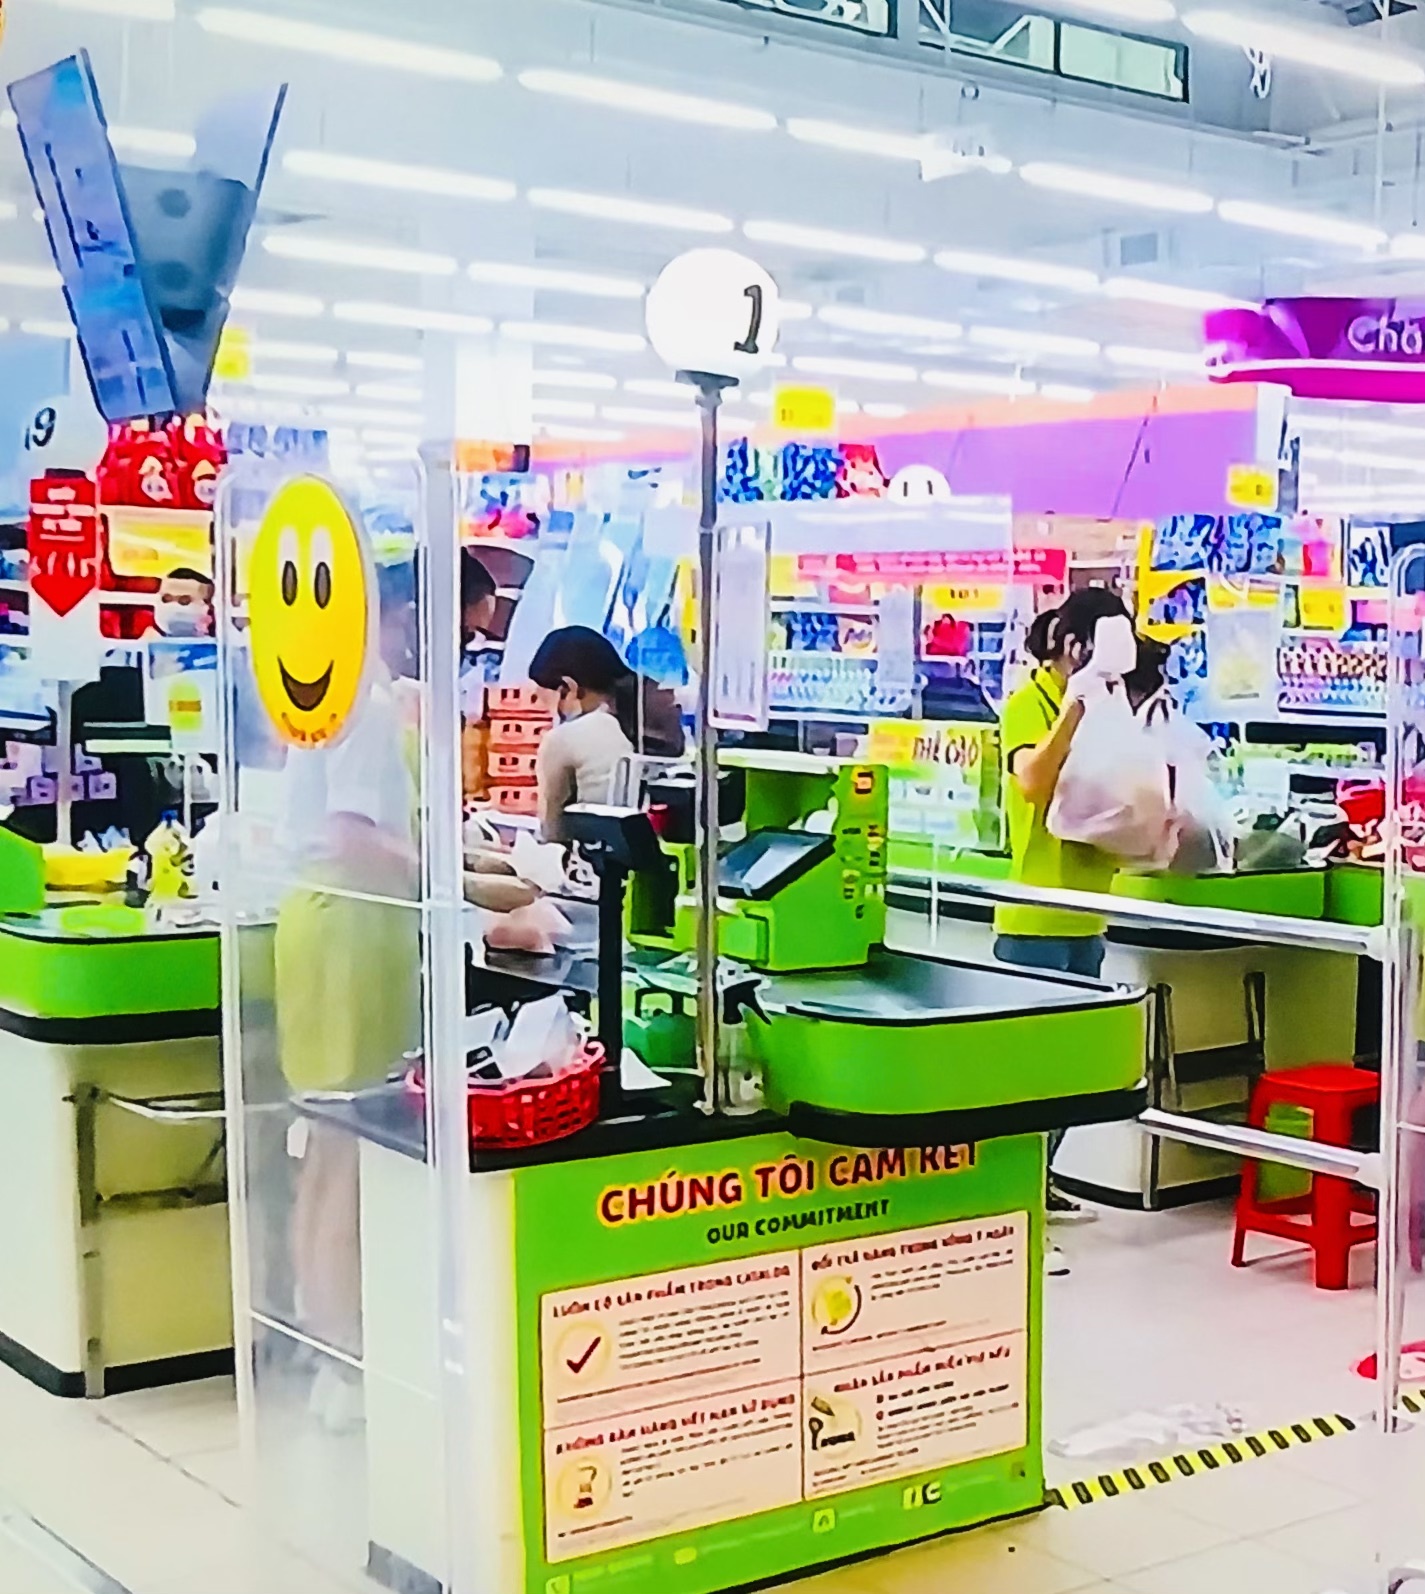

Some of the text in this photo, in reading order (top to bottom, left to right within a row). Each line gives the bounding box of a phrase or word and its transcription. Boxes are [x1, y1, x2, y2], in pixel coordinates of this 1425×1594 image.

[600, 1170, 742, 1222] CHÚNG
[755, 1154, 814, 1198] TÔI
[707, 1199, 889, 1244] OUR COMMITMENT
